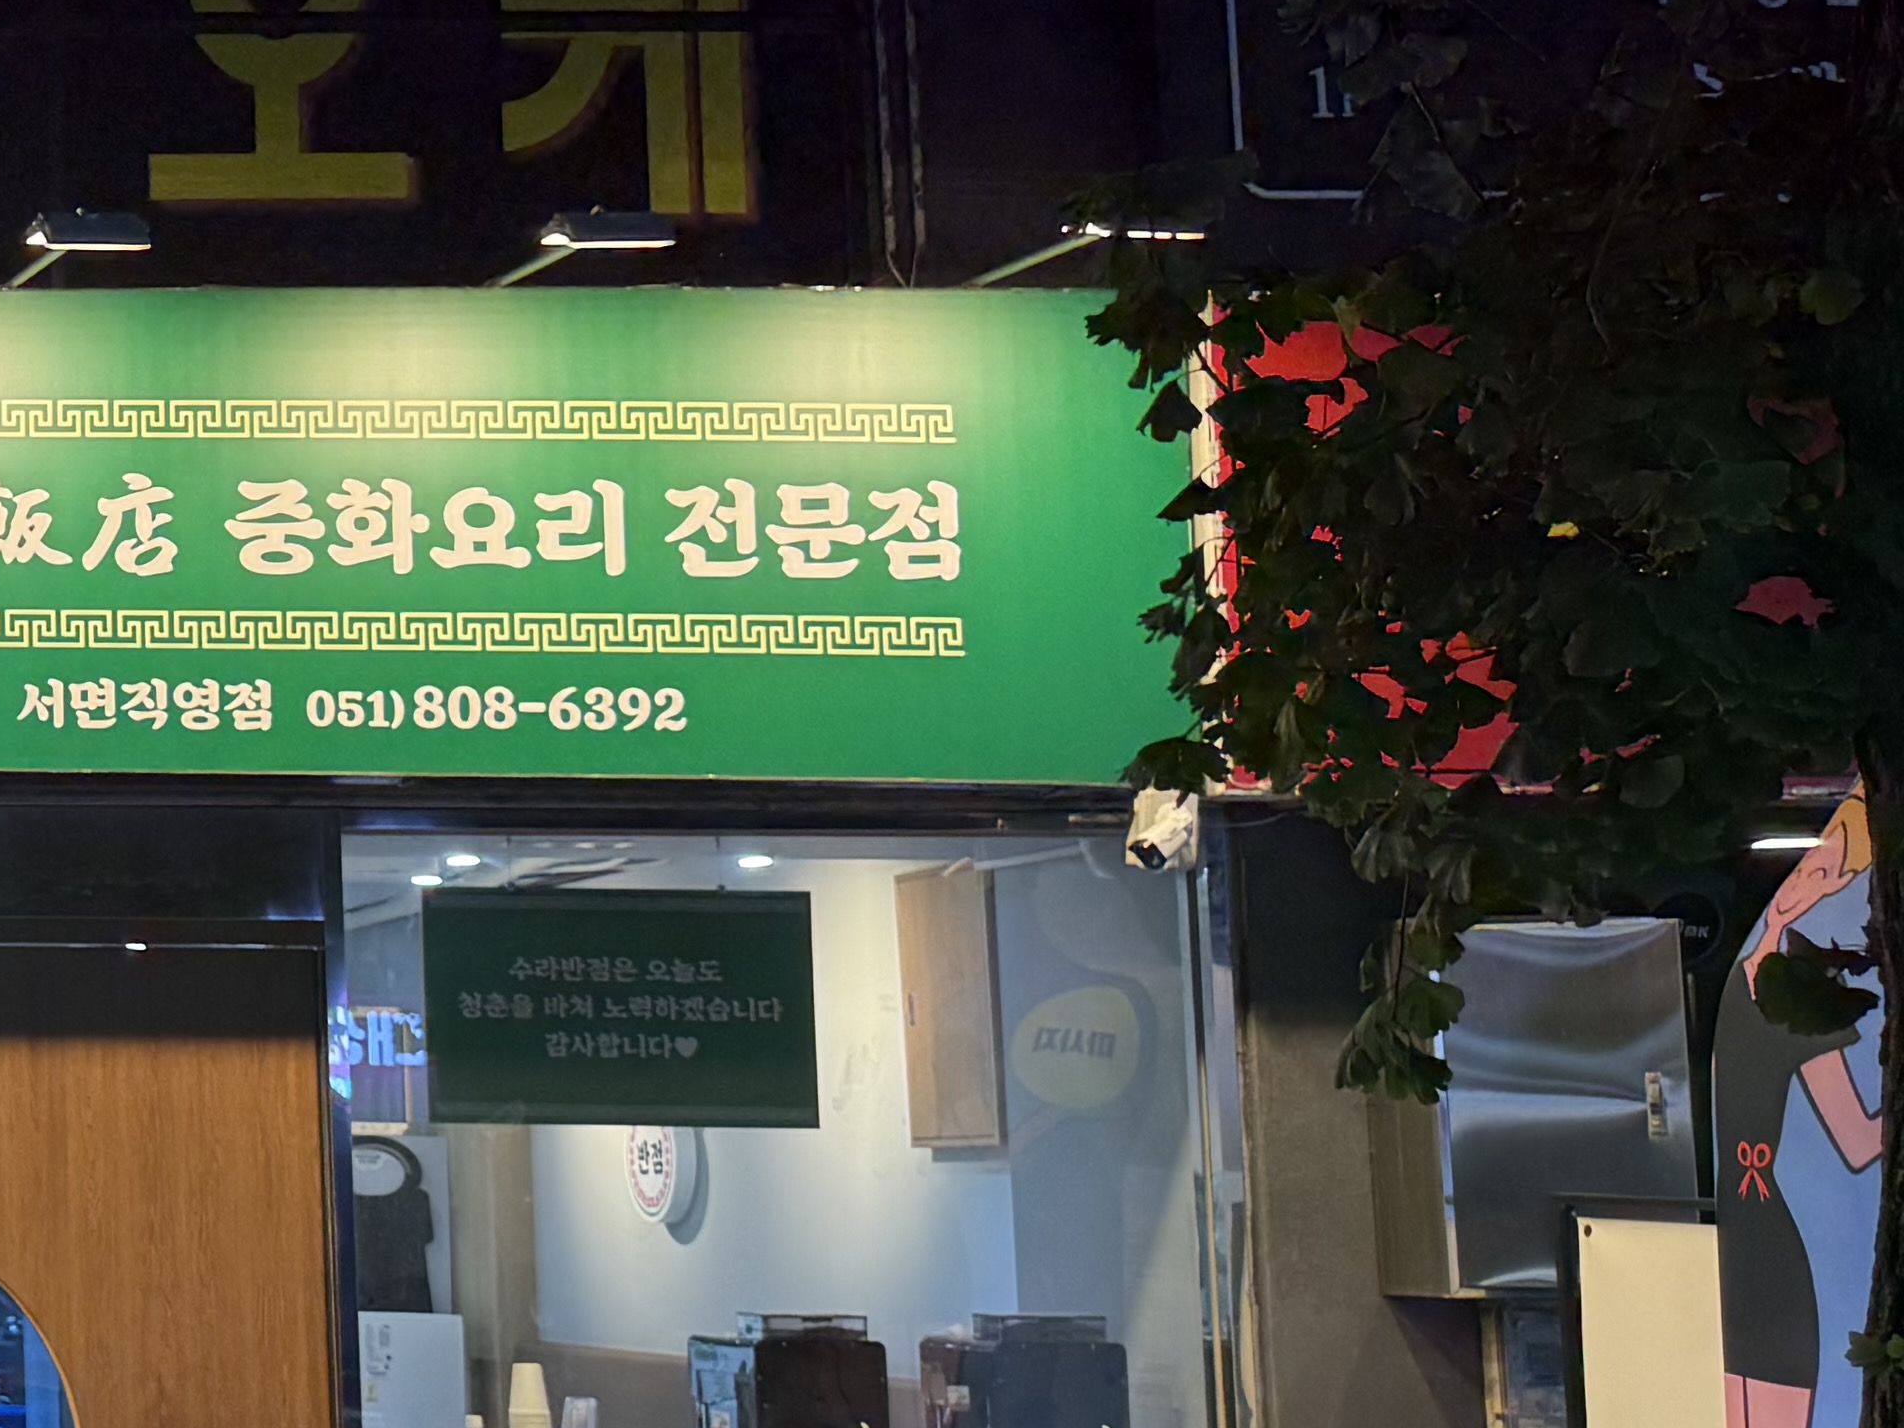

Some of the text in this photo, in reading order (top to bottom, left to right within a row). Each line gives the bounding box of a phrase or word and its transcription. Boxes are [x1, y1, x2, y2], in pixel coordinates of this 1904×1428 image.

[224, 477, 625, 578] 중화요리
[665, 480, 964, 582] 전문점
[16, 678, 275, 733] 서면직영점
[508, 955, 724, 984] 수라반점은 오늘도
[457, 992, 534, 1020] 청춘을
[601, 995, 783, 1023] 노력하겠습니다
